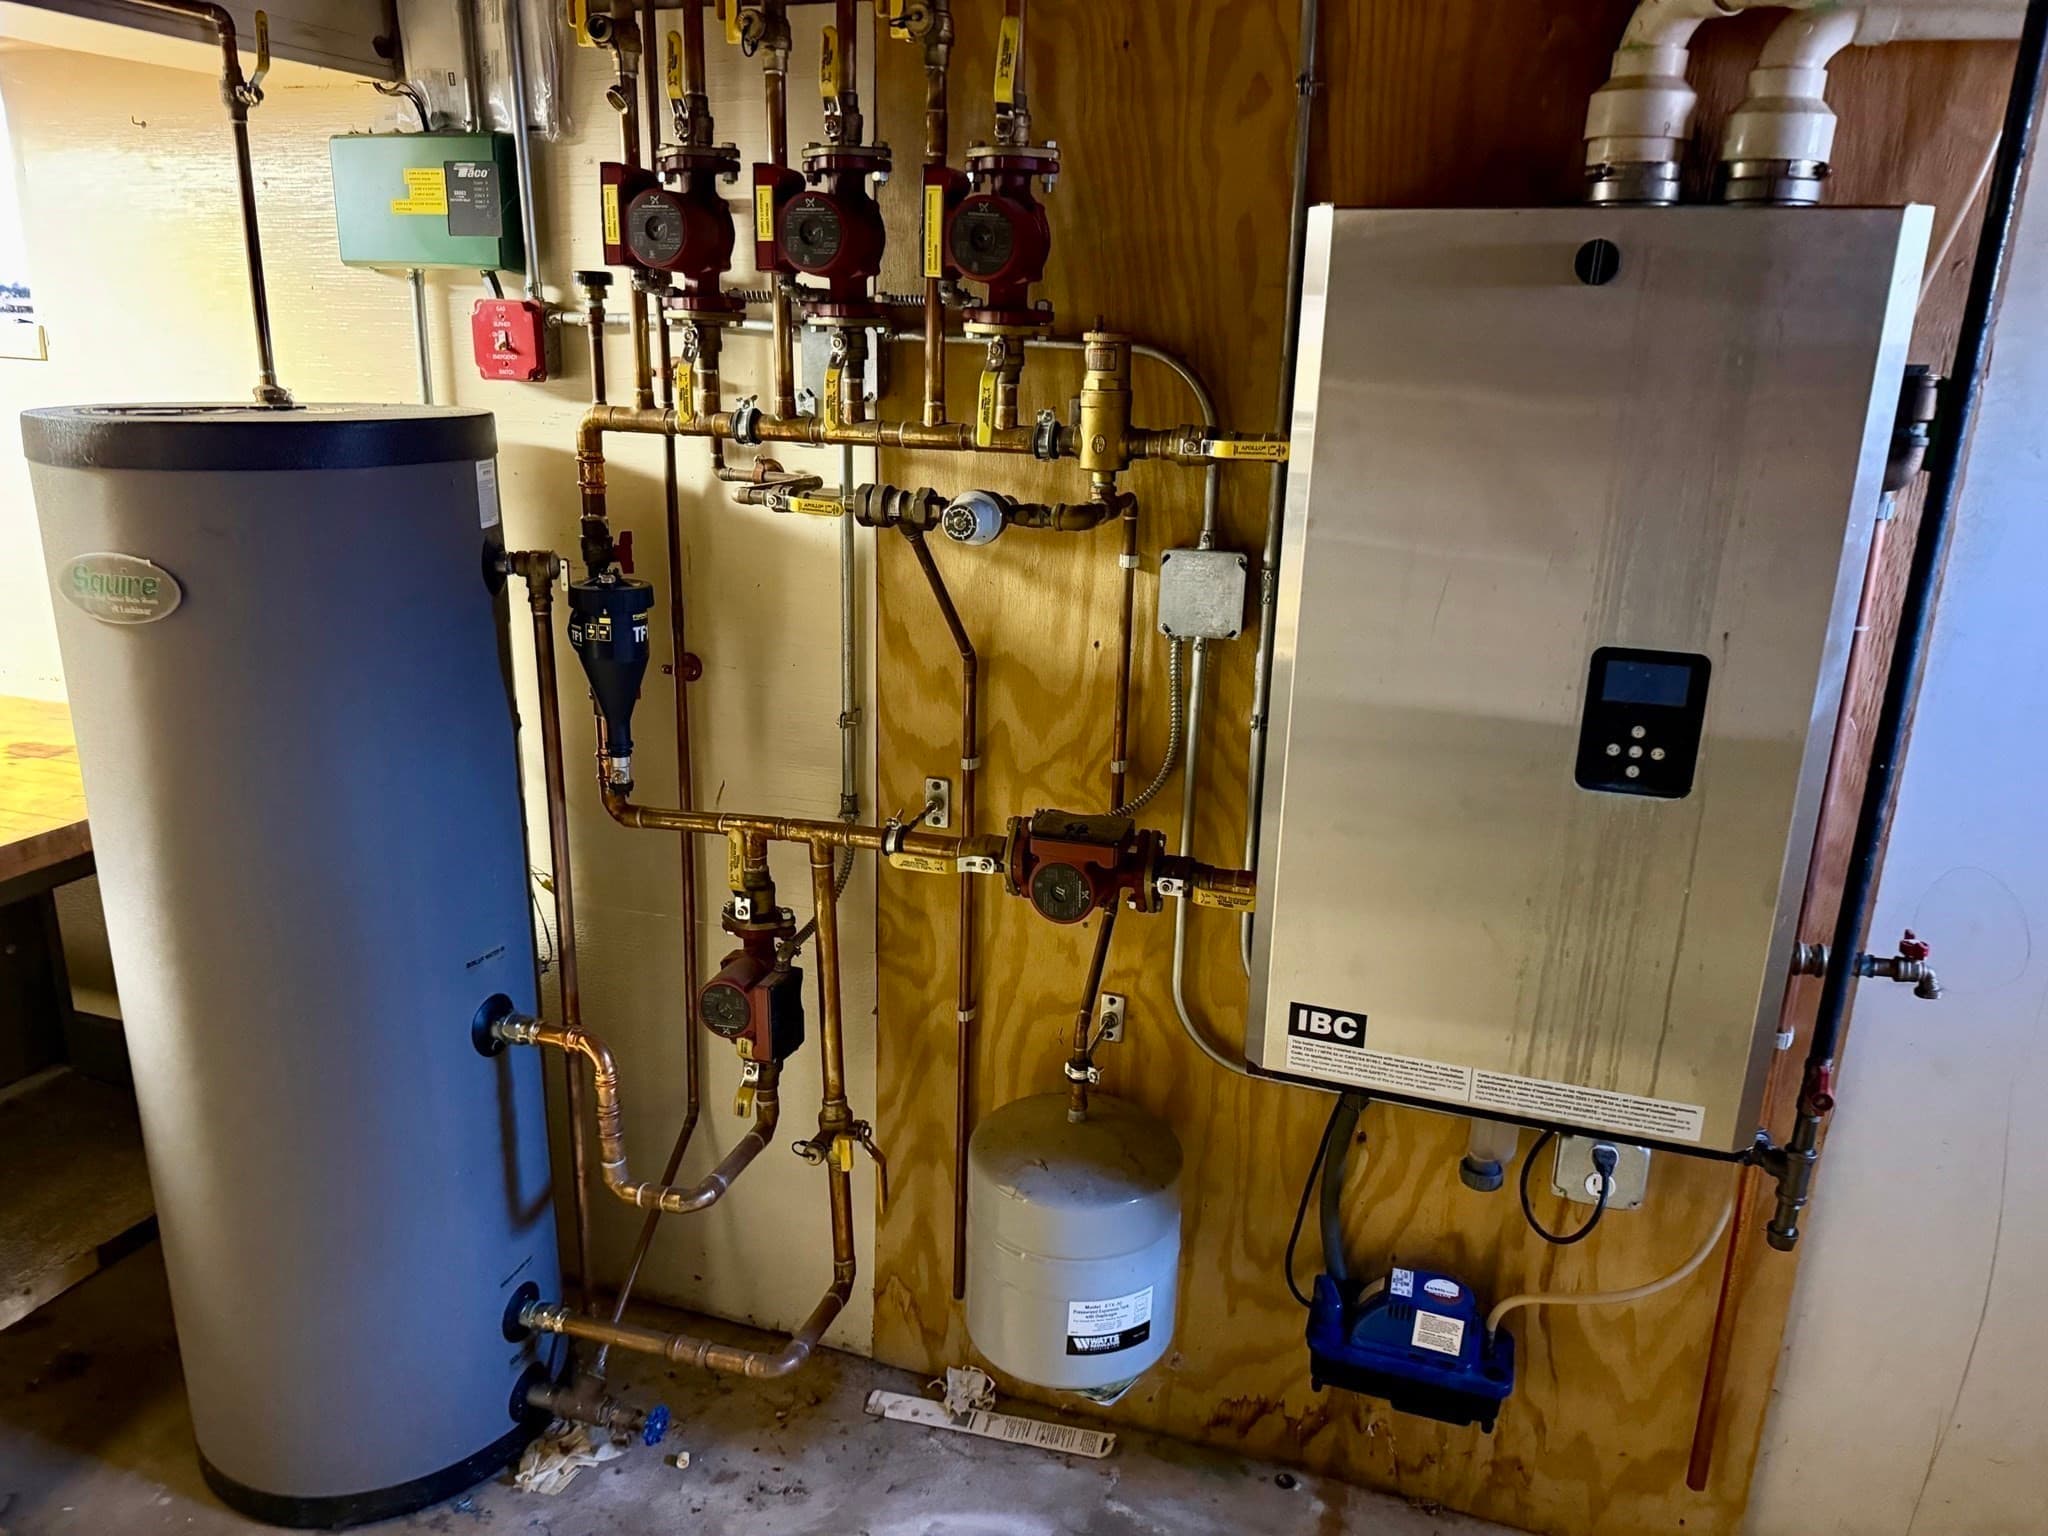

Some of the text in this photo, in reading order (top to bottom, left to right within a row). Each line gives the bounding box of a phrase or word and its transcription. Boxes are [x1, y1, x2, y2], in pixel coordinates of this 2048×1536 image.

[453, 163, 489, 178] Taco
[73, 564, 158, 597] Squire
[571, 629, 582, 642] TF1
[1298, 1009, 1358, 1039] IBC
